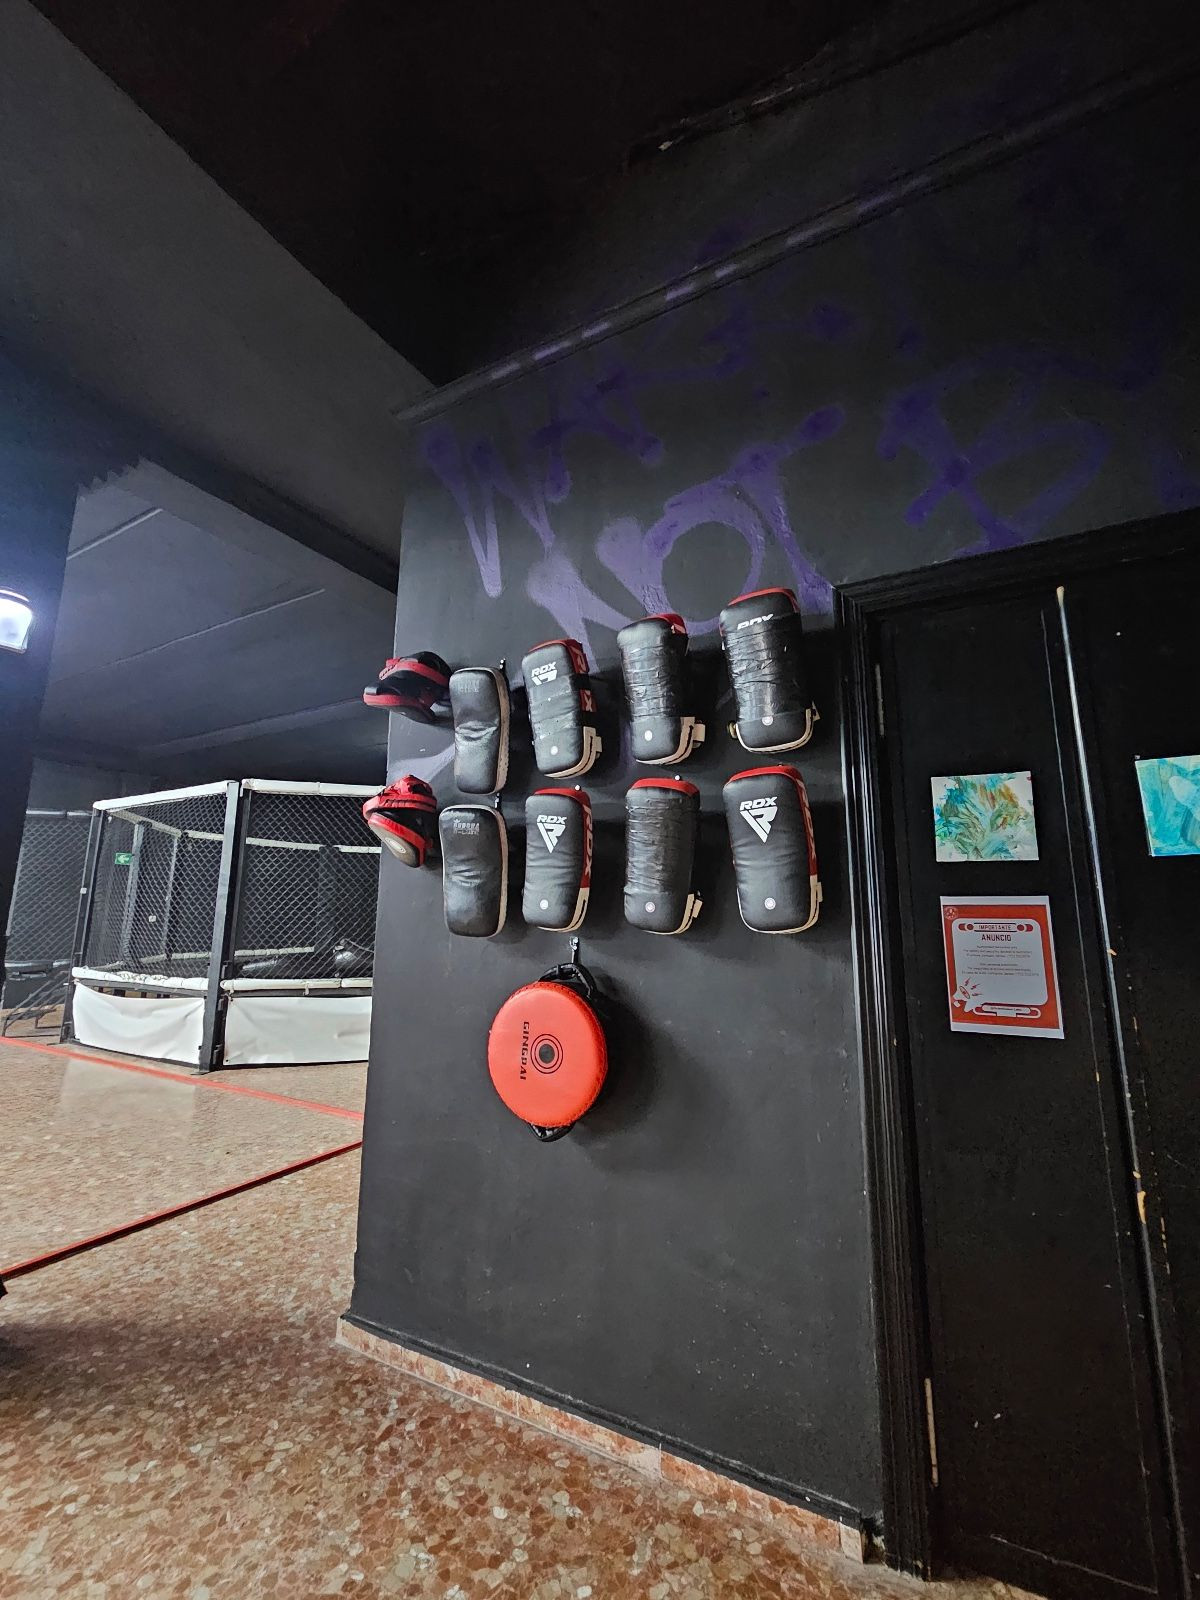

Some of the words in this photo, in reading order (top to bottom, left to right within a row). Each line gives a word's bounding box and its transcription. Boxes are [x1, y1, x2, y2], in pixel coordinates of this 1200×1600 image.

[531, 661, 556, 677] RDX
[739, 796, 777, 811] RDX
[536, 814, 568, 824] RDX
[583, 804, 593, 879] RDX
[981, 933, 1012, 942] ANUNCIO
